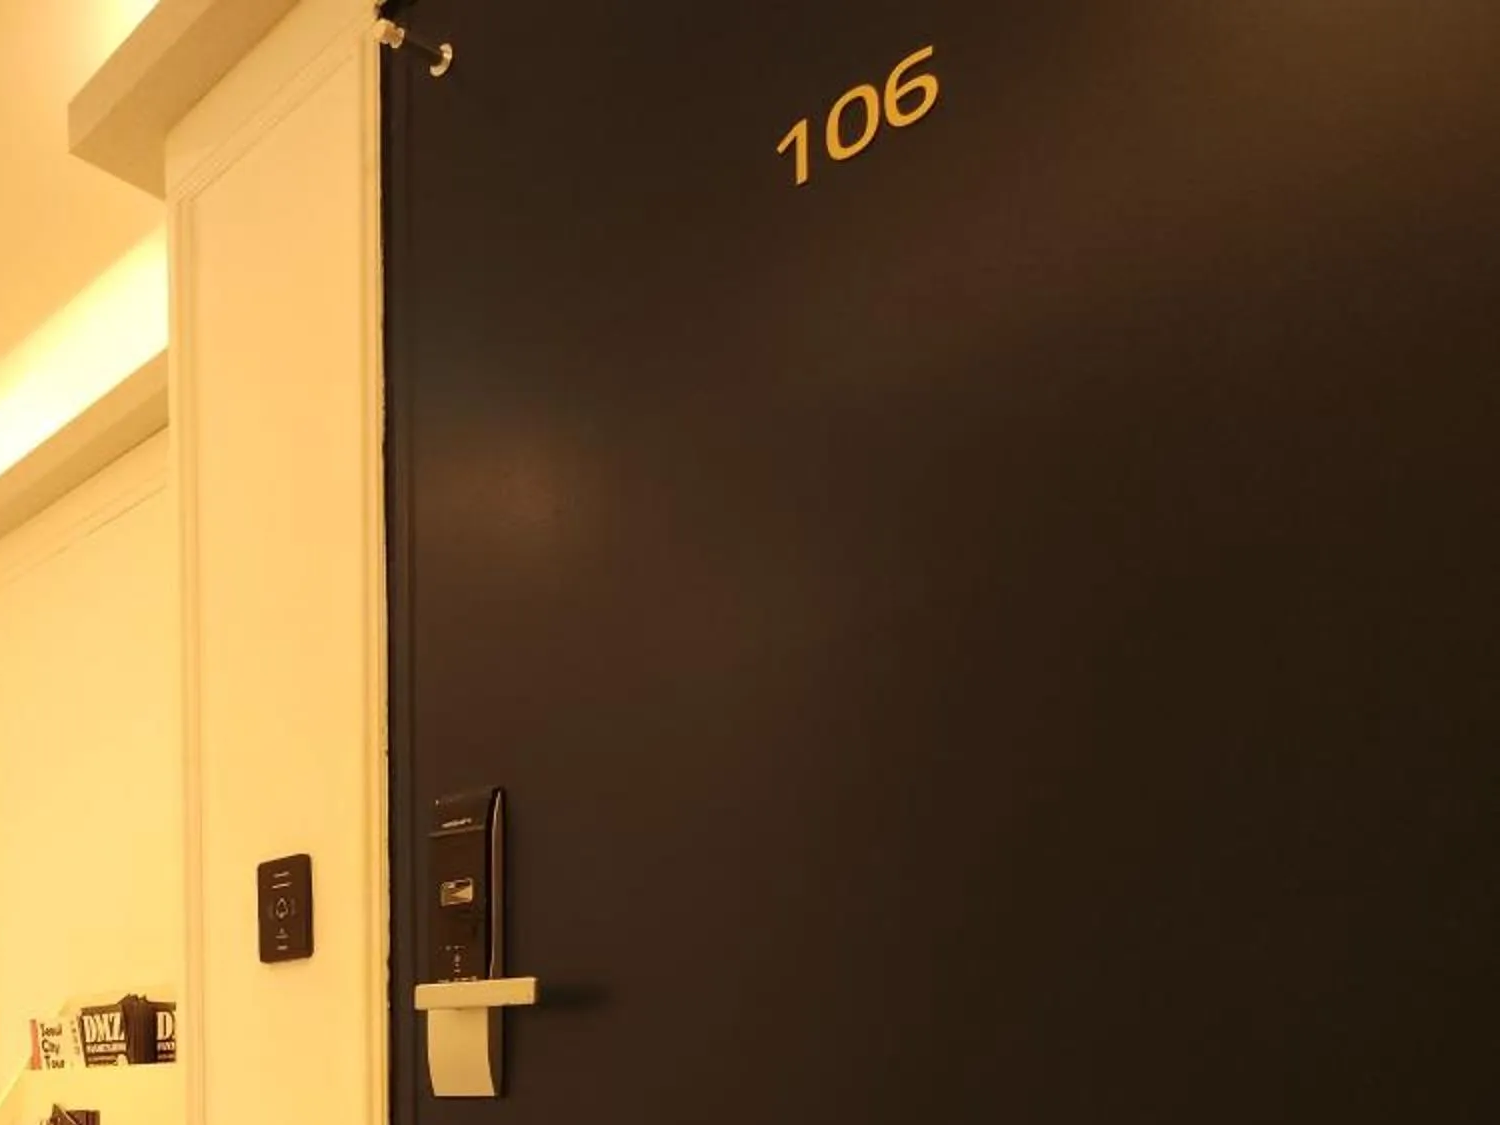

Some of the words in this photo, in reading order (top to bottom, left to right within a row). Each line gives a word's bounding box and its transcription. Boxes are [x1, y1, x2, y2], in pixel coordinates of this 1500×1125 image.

[775, 44, 940, 186] 106
[40, 1023, 62, 1038] Seoul
[83, 1011, 125, 1043] DMZ
[41, 1038, 60, 1056] City
[44, 1054, 65, 1070] Tour
